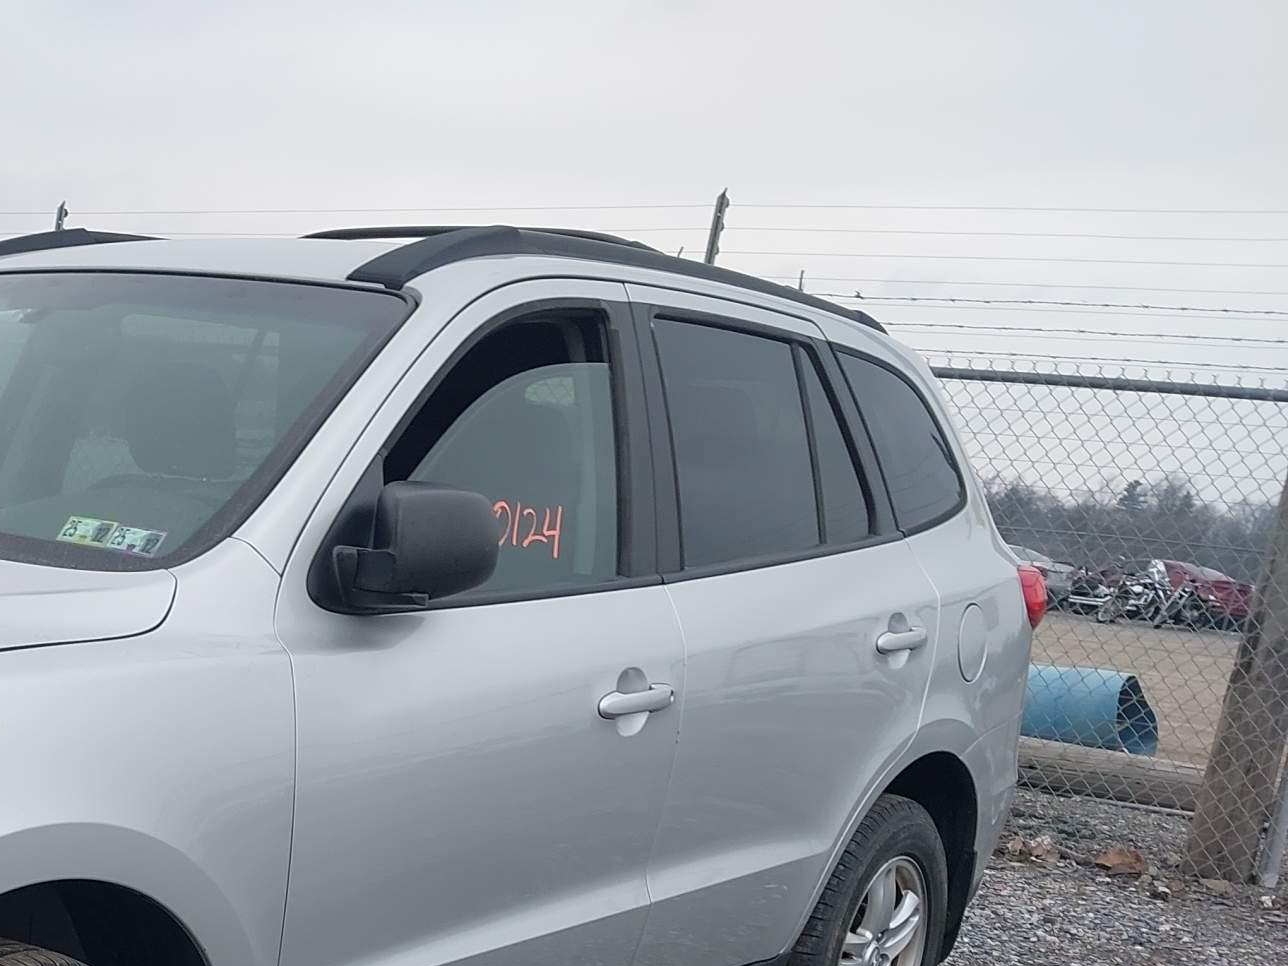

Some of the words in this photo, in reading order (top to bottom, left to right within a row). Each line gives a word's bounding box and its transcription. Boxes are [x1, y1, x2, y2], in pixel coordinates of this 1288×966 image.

[62, 520, 82, 537] 25
[91, 526, 111, 543] 12
[111, 527, 130, 545] 25
